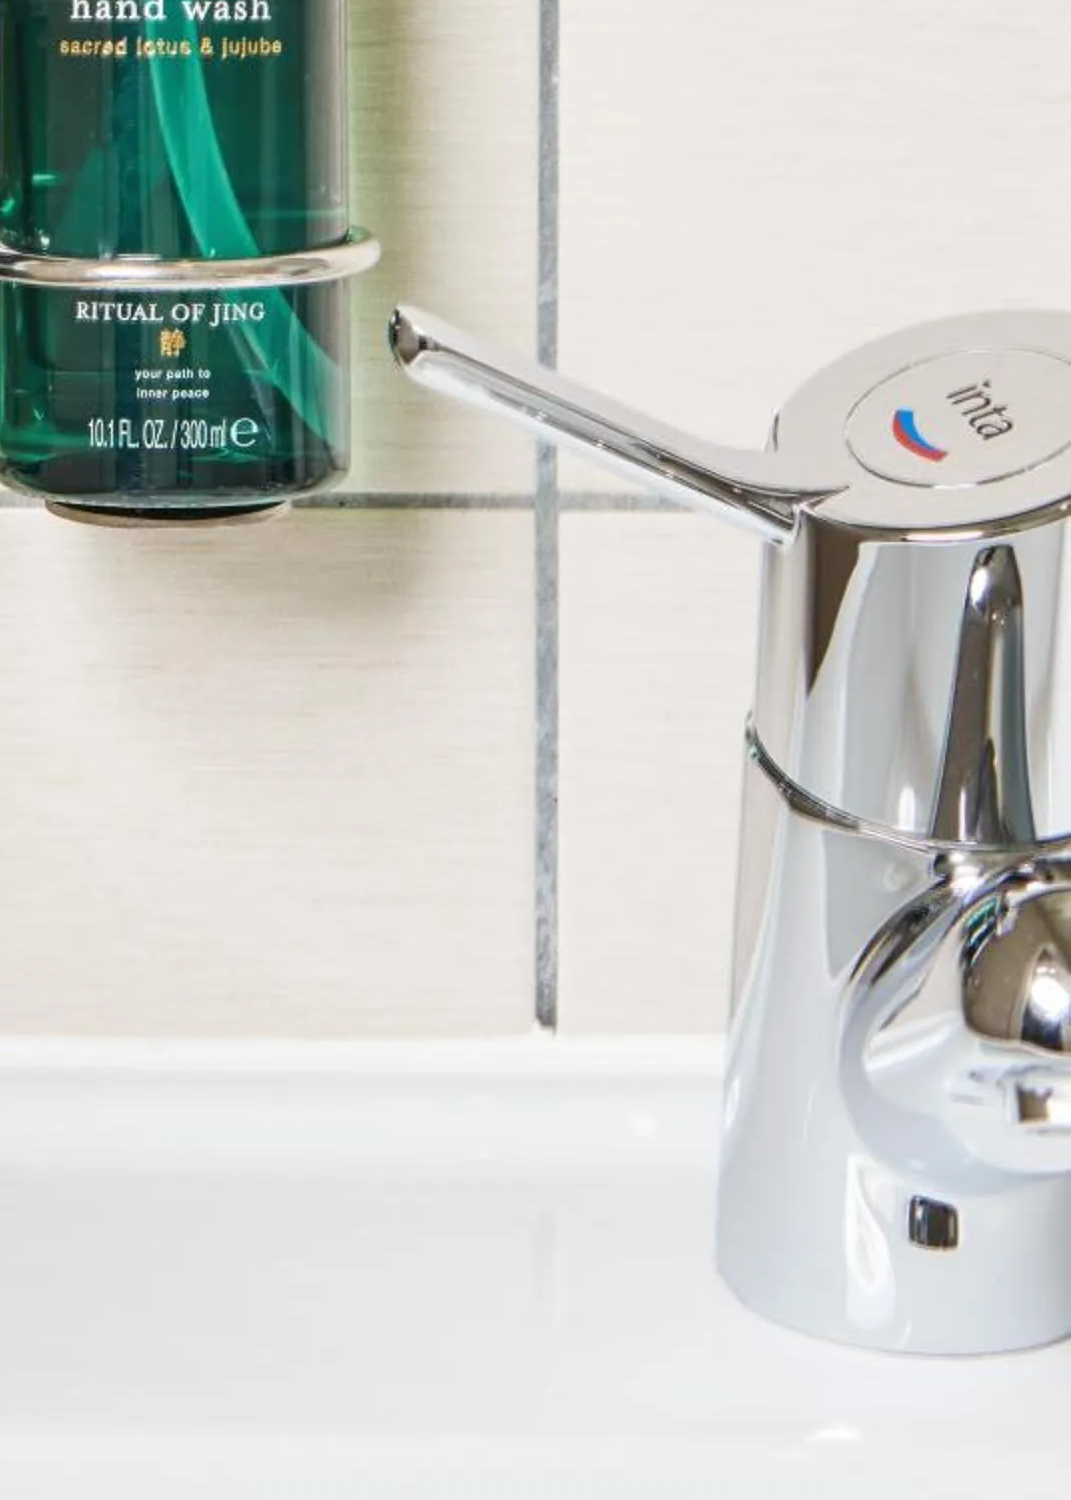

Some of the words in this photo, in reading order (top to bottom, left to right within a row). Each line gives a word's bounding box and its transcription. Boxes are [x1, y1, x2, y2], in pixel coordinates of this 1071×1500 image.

[59, 36, 128, 57] sacred
[135, 36, 193, 57] lotus
[199, 36, 214, 56] &
[221, 37, 283, 60] jujube
[75, 301, 164, 323] RITUAL
[171, 302, 206, 323] OF
[209, 301, 265, 328] JING
[135, 368, 163, 381] your
[166, 366, 194, 381] path
[198, 367, 212, 379] to
[136, 386, 169, 399] inner
[172, 388, 210, 401] peace
[945, 379, 1014, 441] inta
[88, 416, 115, 448] 10.1
